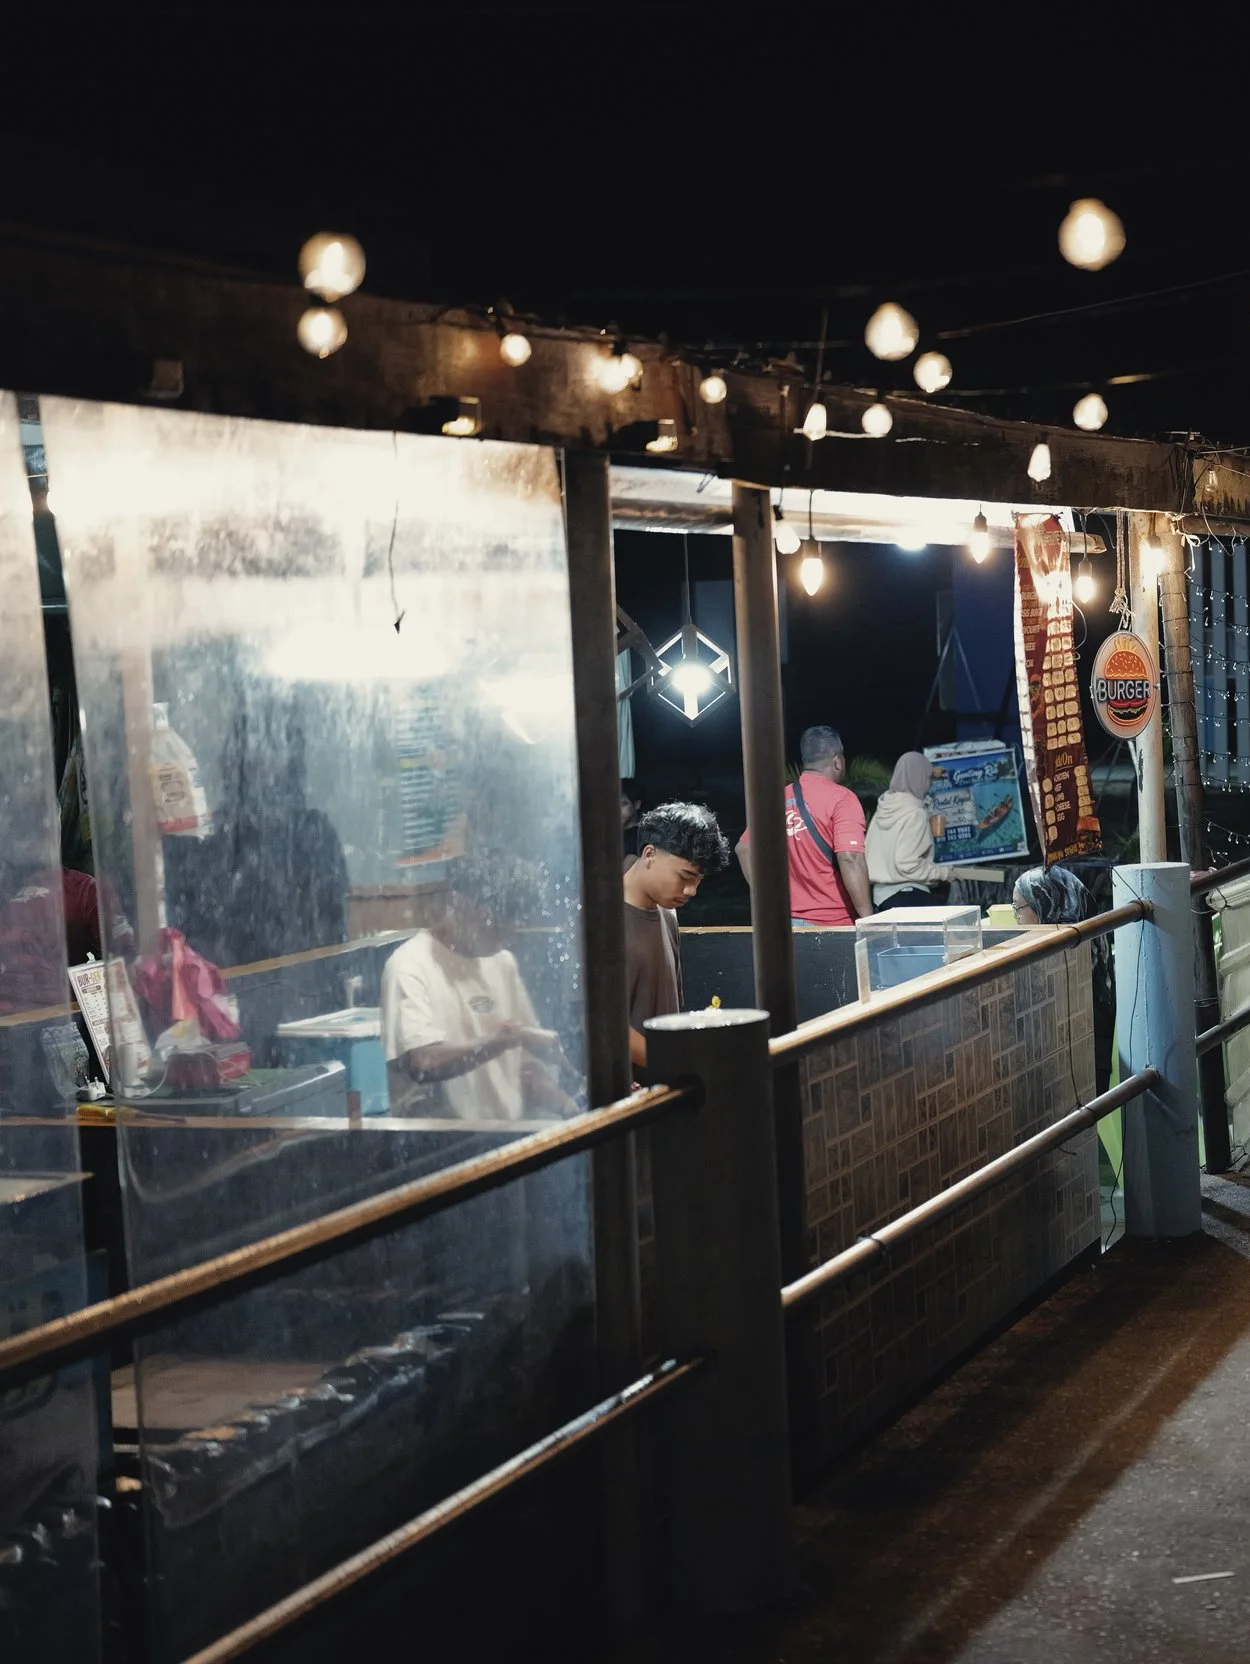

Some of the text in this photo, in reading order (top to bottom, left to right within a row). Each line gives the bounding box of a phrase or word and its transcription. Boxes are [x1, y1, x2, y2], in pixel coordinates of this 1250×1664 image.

[1097, 679, 1151, 701] BURGER
[953, 768, 983, 785] Genting
[932, 797, 953, 812] Rental
